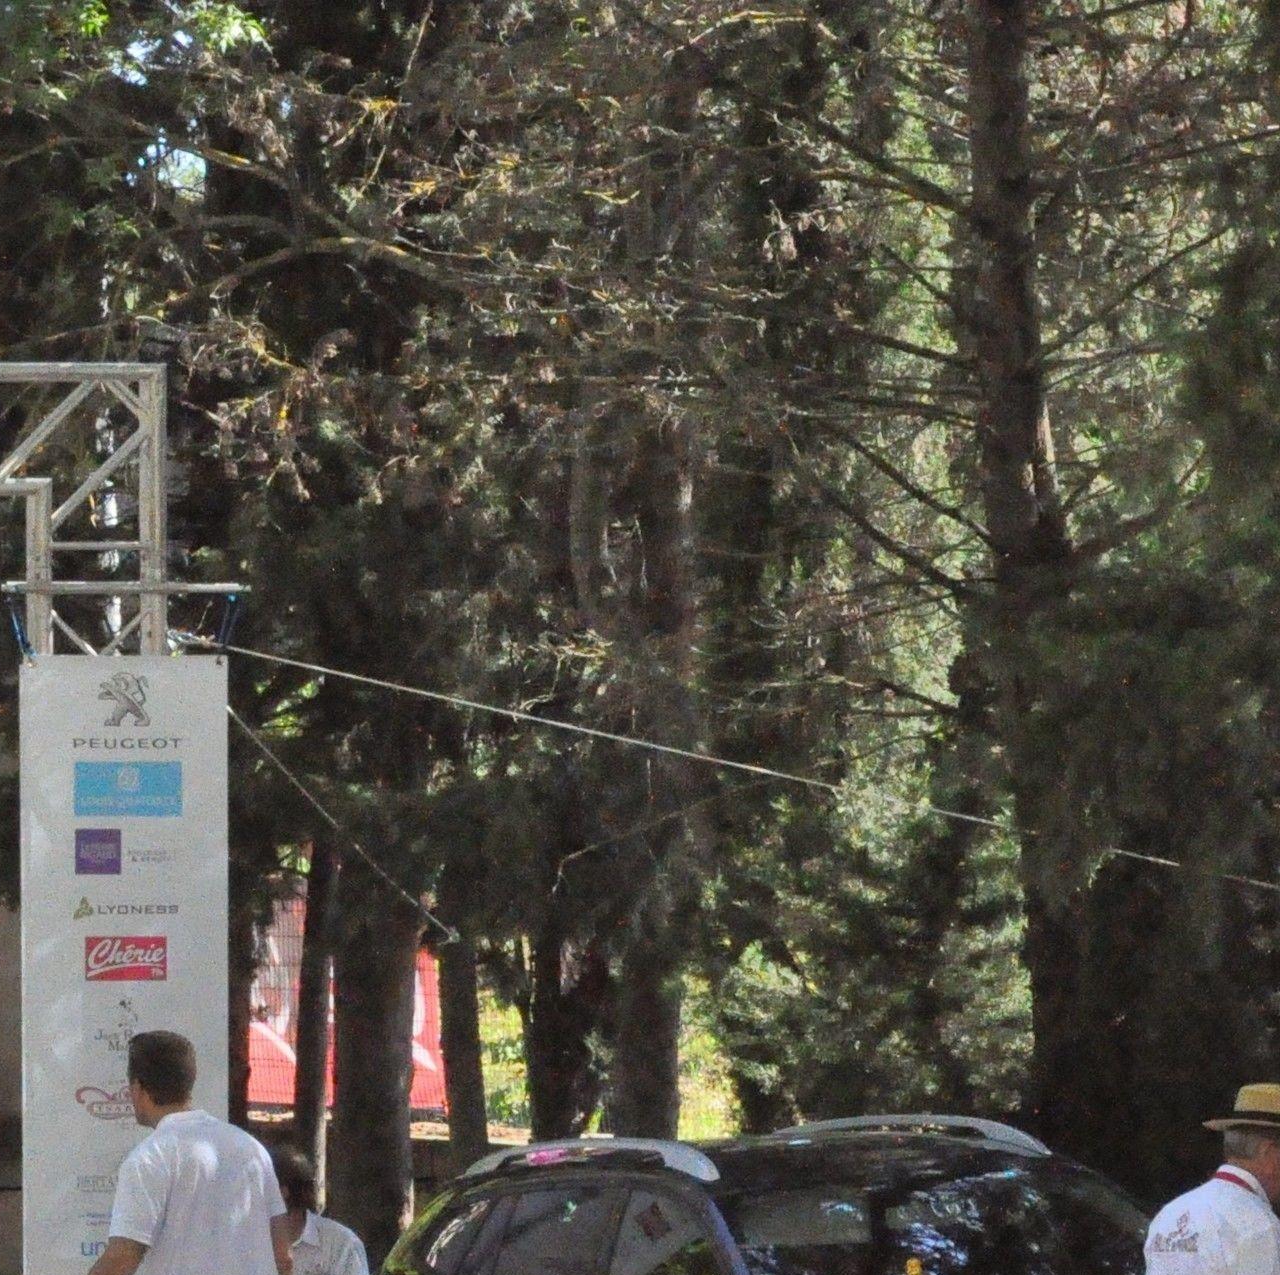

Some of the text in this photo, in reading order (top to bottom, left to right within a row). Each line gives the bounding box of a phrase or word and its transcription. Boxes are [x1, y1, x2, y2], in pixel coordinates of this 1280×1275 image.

[72, 737, 182, 749] PEUGEOT
[96, 904, 179, 915] LYONESS
[87, 938, 166, 970] Chérie
